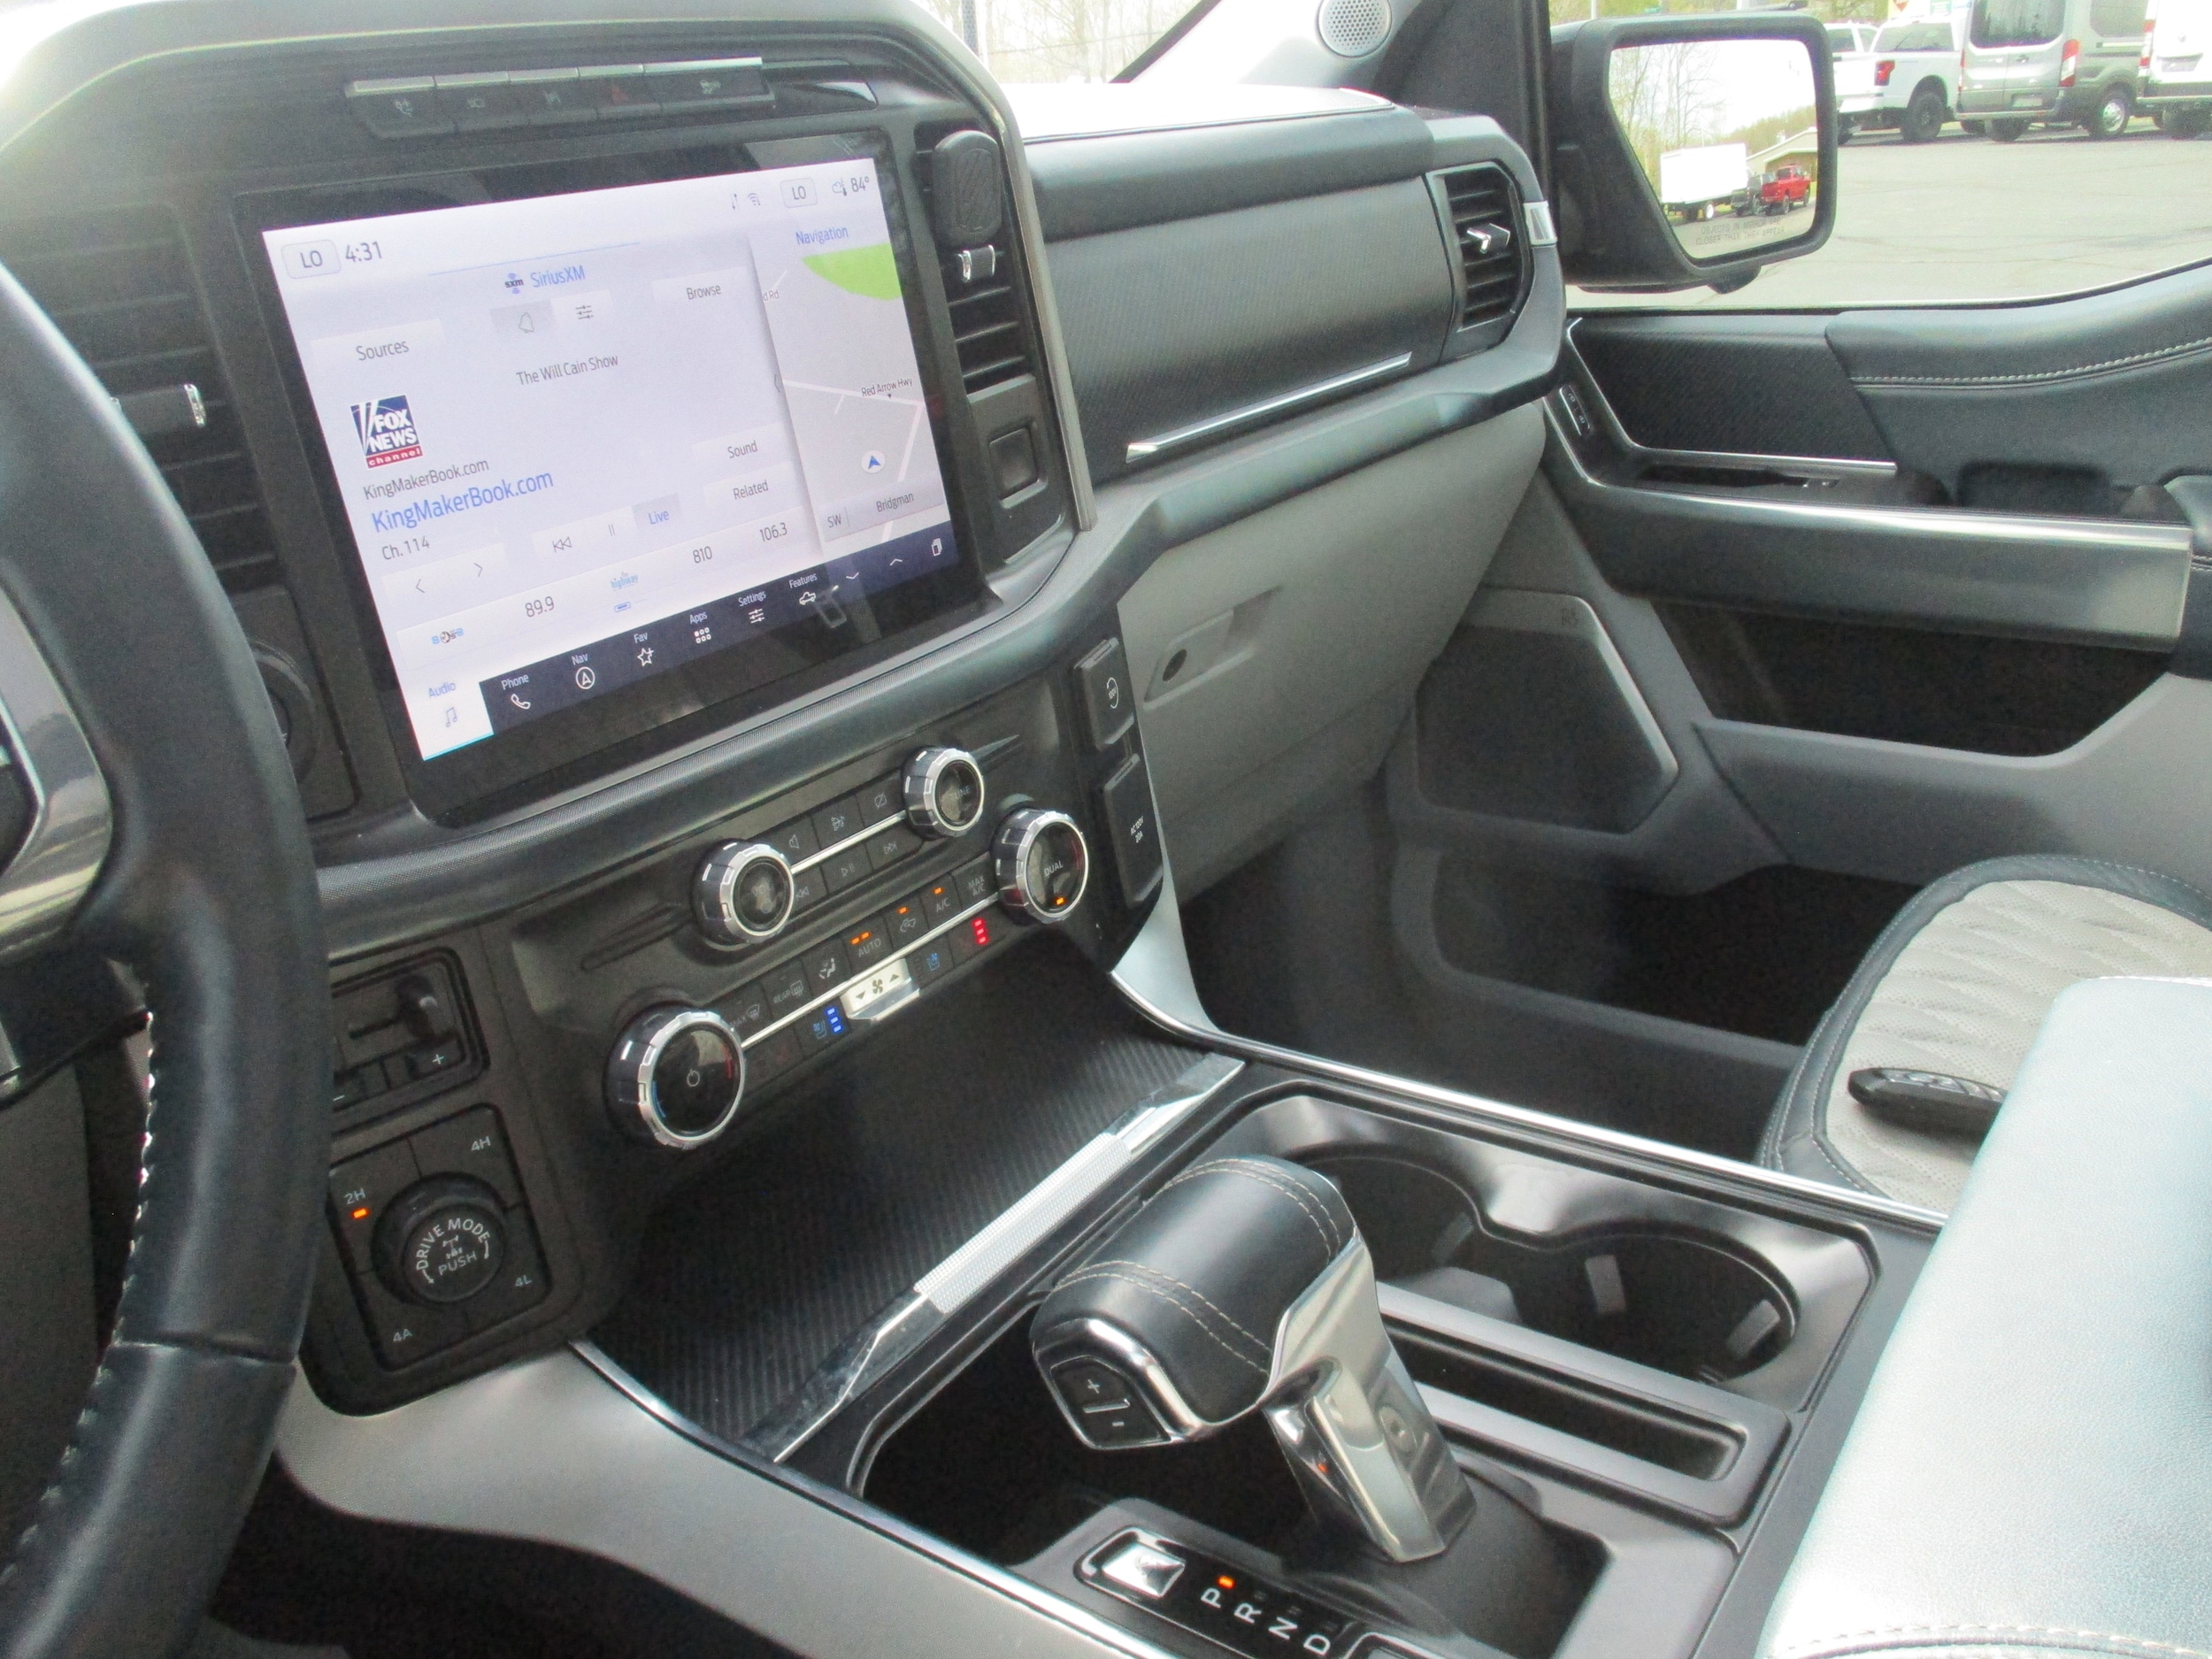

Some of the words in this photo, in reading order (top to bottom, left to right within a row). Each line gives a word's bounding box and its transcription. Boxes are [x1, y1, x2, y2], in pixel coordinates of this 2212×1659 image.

[792, 185, 807, 201] LO
[795, 227, 849, 245] Navigation
[300, 250, 323, 268] LO
[345, 241, 382, 263] 4:31
[530, 265, 586, 288] SiriusXM
[686, 285, 722, 301] Browse
[356, 339, 410, 361] Sources
[516, 372, 540, 386] The
[540, 364, 564, 380] Will
[563, 360, 588, 376] Cain
[588, 356, 618, 372] Show
[861, 384, 876, 397] Red
[877, 381, 897, 393] Arrow
[896, 378, 913, 388] Hwy
[373, 409, 413, 434] FOX
[368, 427, 418, 453] NEWS
[727, 439, 758, 459] Sound
[368, 447, 421, 466] channel
[363, 459, 490, 500] KingMakerBook.com
[733, 479, 770, 501] Related
[372, 472, 555, 534] KingMakerBook.com
[876, 492, 915, 513] Bridgman
[649, 509, 670, 526] Live
[827, 513, 841, 528] SW
[759, 522, 787, 542] 106.3
[403, 535, 430, 554] 114
[693, 546, 713, 565] 810
[788, 572, 818, 589] Features
[525, 595, 556, 618] 89.9
[738, 590, 767, 607] Settings
[689, 611, 709, 625] Apps
[634, 631, 649, 644] Fav
[572, 652, 589, 665] Nav
[428, 681, 457, 698] Audio
[501, 673, 530, 690] Phone
[1043, 860, 1064, 878] DUAL
[968, 876, 985, 888] MAX
[972, 885, 986, 896] A/C
[935, 897, 950, 913] A/C
[857, 938, 881, 957] AUTO
[471, 1136, 490, 1152] 4H
[344, 1188, 365, 1204] 2H
[416, 1225, 444, 1271] DRIVE
[448, 1217, 491, 1243] MODE
[437, 1250, 478, 1276] PUSH
[515, 1274, 532, 1287] 4L
[392, 1328, 413, 1342] 4A
[1200, 1587, 1221, 1609] P
[1233, 1602, 1262, 1624] R
[1268, 1617, 1298, 1640] N
[1303, 1633, 1331, 1656] D
